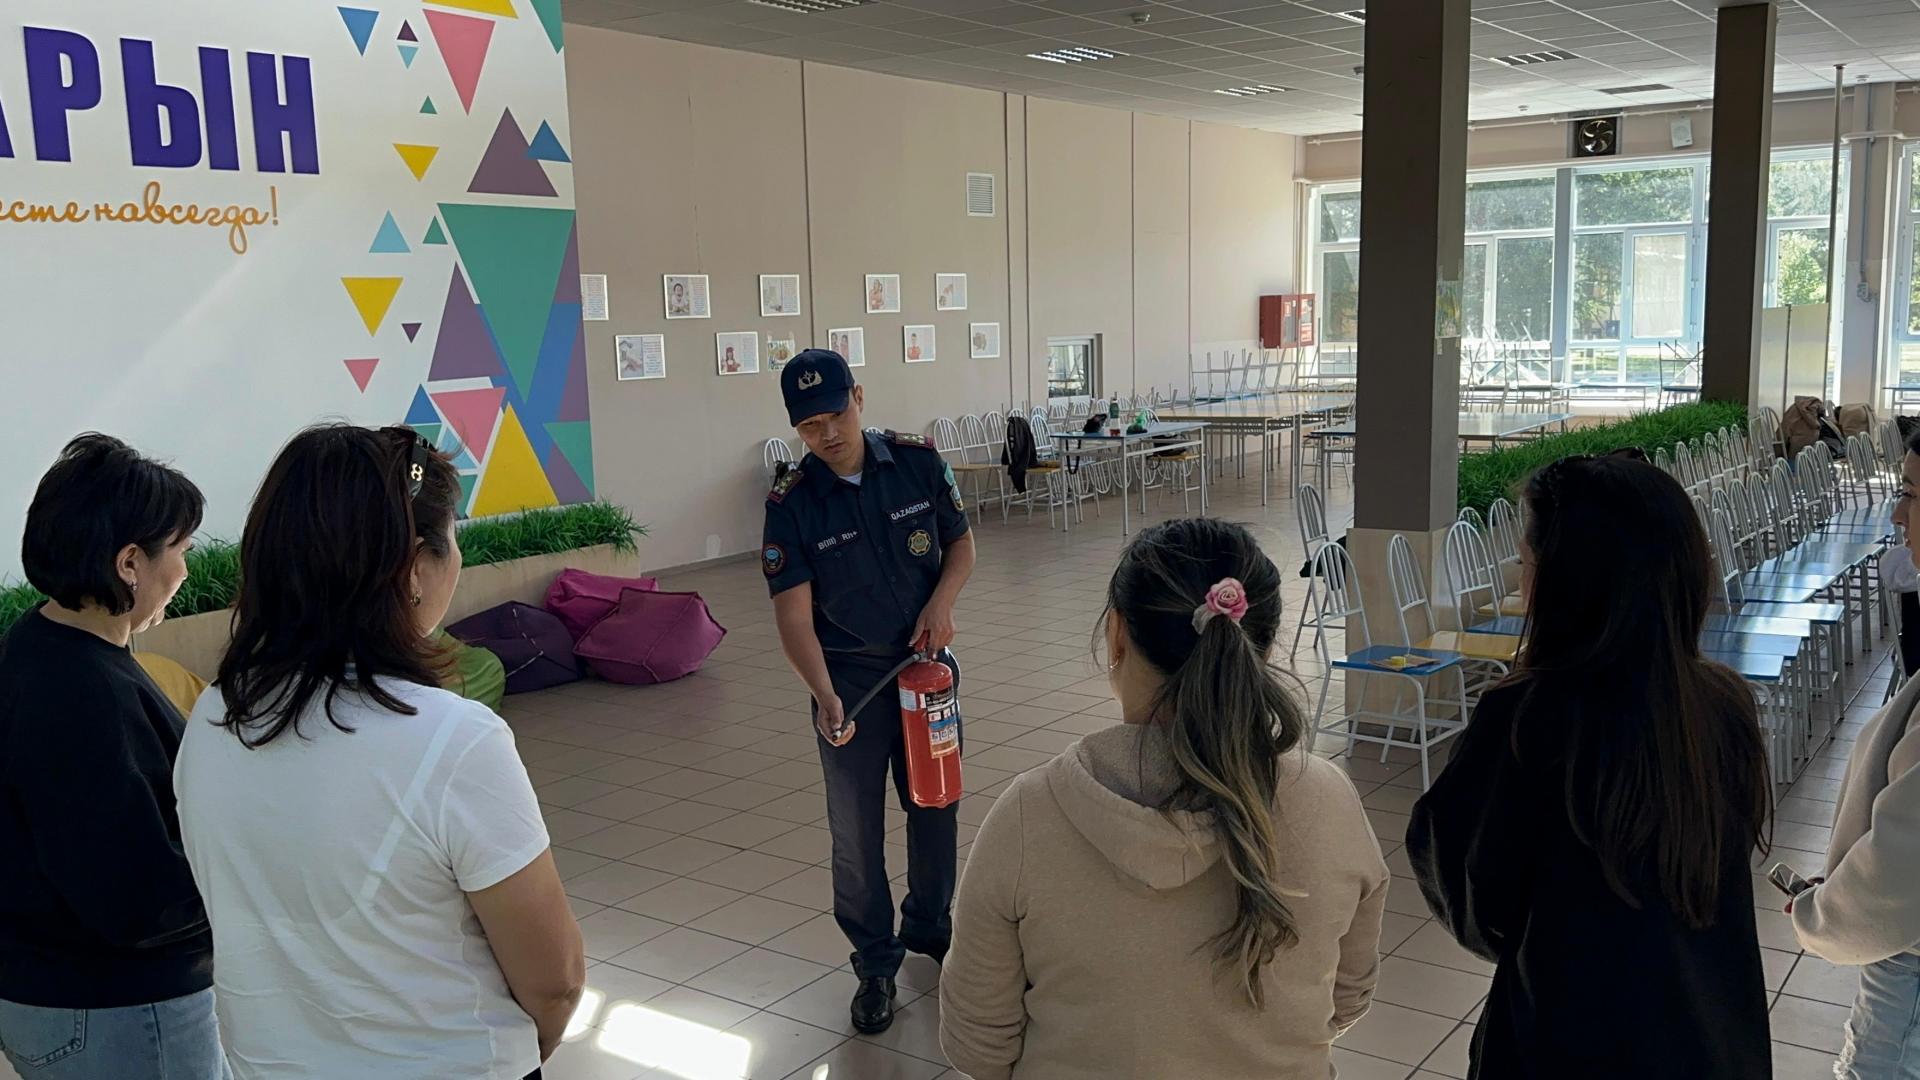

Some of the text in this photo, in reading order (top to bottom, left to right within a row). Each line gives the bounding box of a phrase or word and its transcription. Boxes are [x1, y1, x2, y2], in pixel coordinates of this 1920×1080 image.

[0, 26, 320, 175] РЫН
[0, 181, 279, 255] сте навсегда!
[890, 501, 930, 520] QAZAQSTAN
